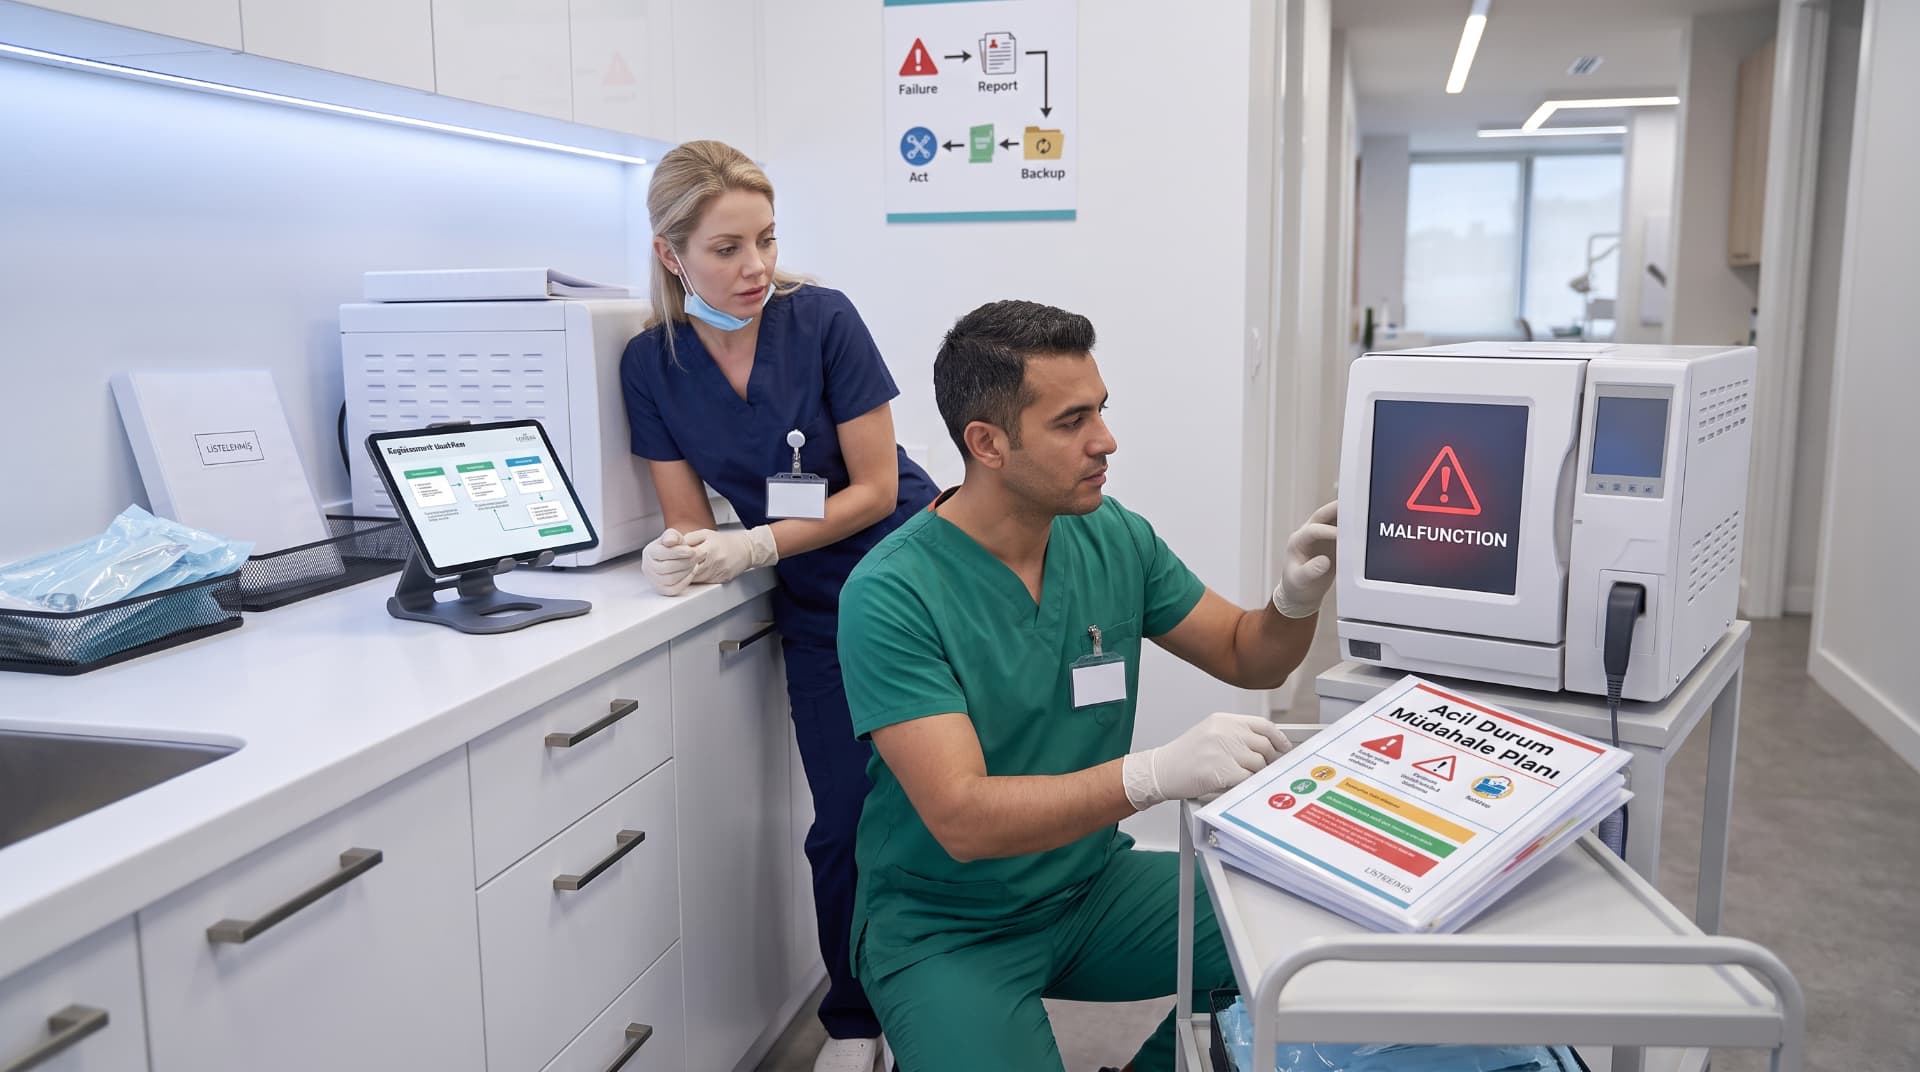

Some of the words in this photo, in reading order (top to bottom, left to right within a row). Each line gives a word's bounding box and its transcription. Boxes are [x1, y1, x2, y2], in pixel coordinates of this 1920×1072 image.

[899, 84, 938, 95] Failure
[978, 81, 1018, 93] Report
[909, 172, 928, 183] Act
[1021, 168, 1066, 181] Backup
[1379, 522, 1508, 547] MALFUNCTION
[1428, 705, 1477, 726] Acil
[1475, 720, 1555, 756] Durum
[1389, 707, 1496, 755] Müdahale
[1498, 749, 1561, 780] Planı
